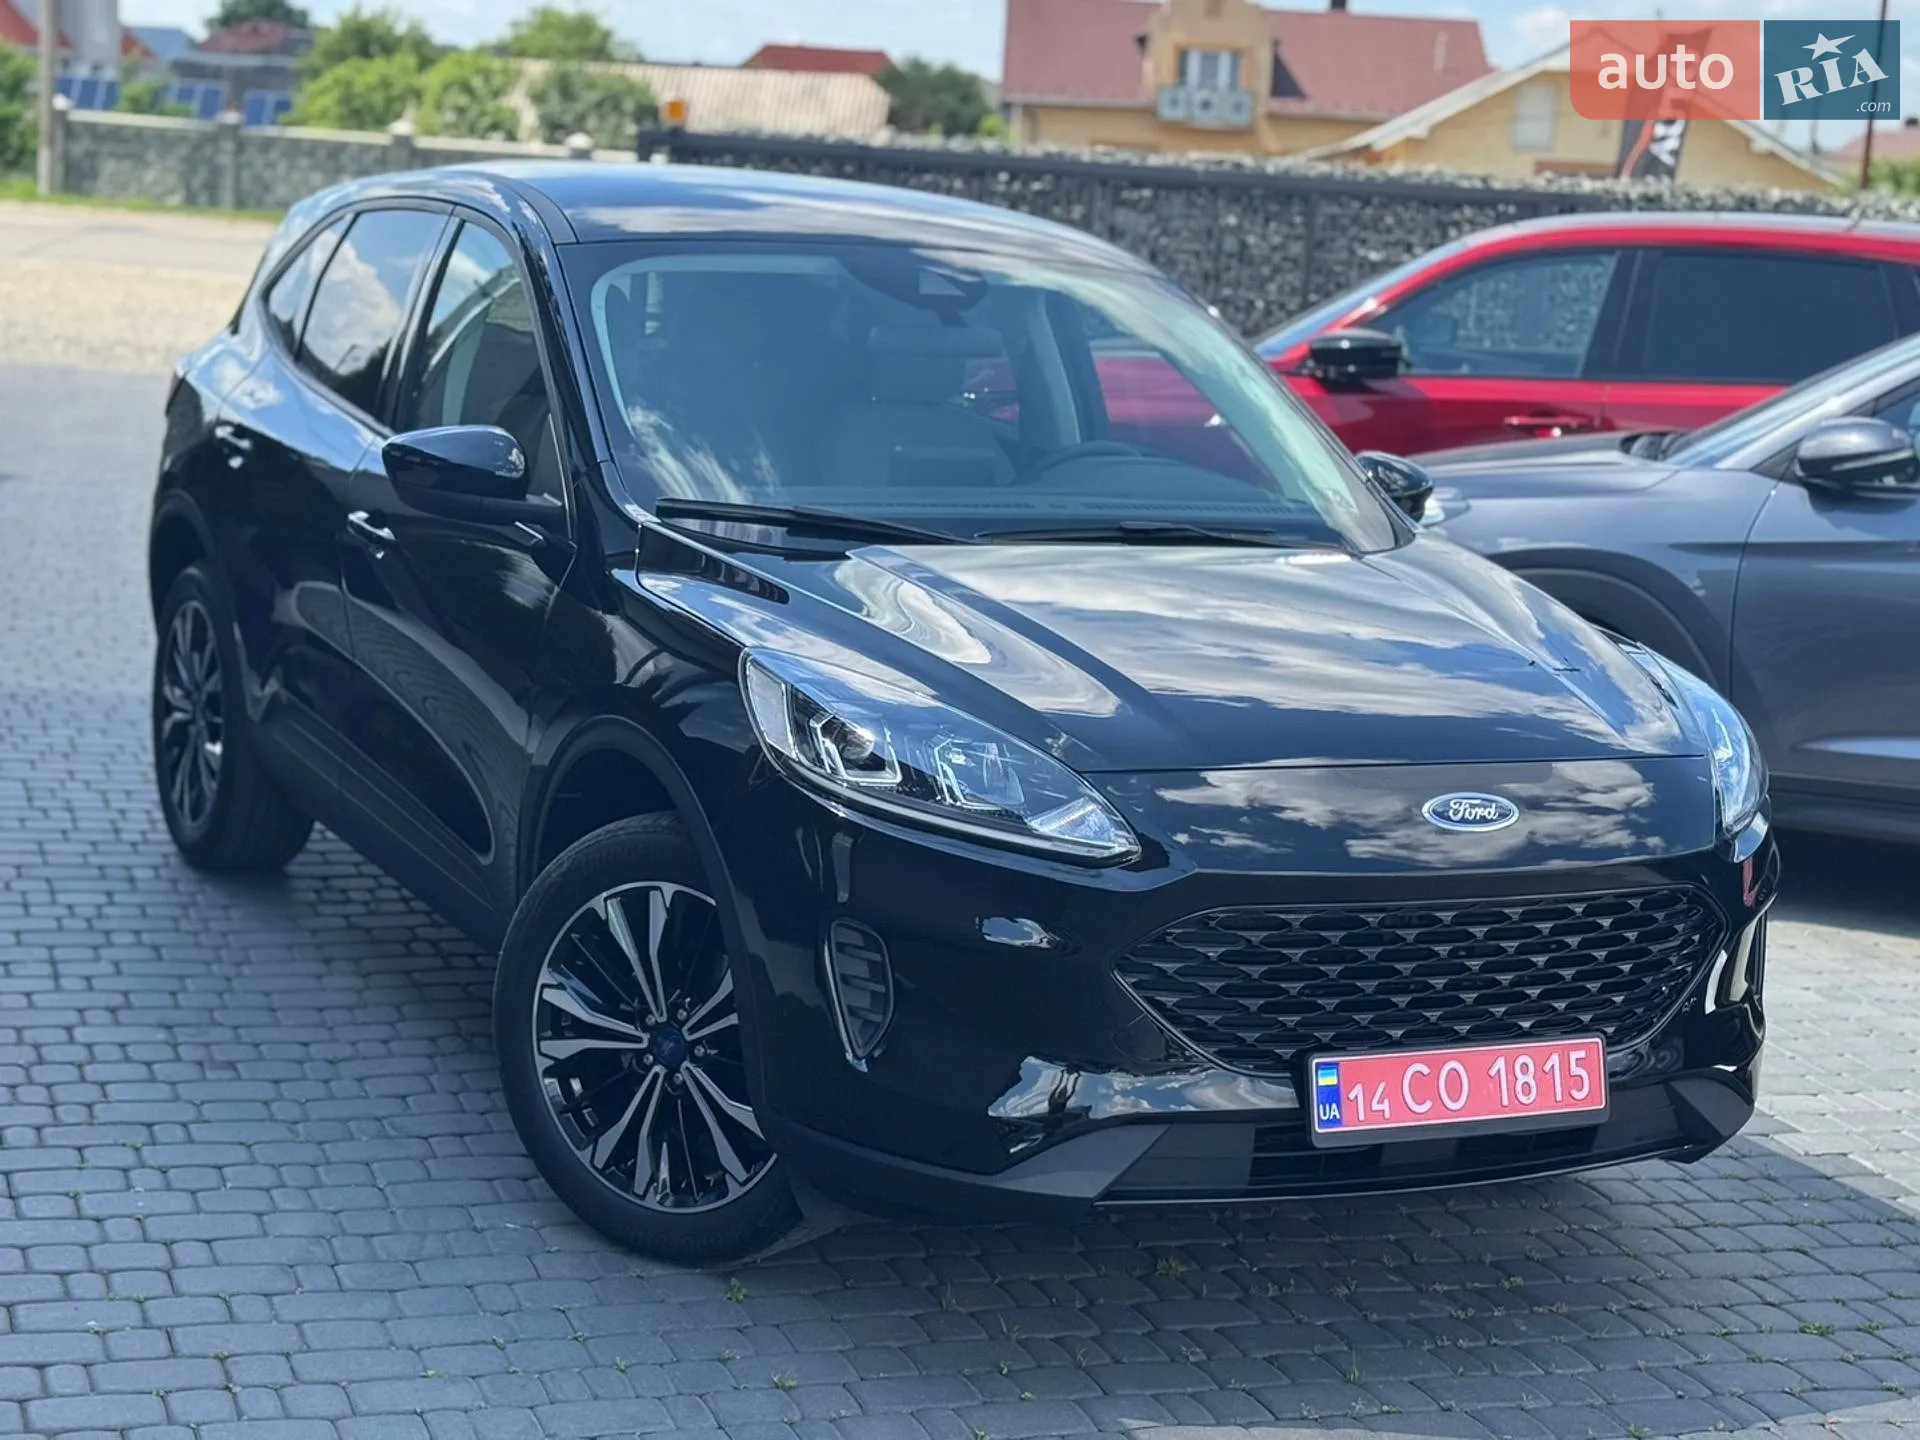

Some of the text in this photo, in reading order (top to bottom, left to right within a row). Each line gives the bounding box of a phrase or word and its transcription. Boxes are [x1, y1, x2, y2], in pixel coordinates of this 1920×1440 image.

[1449, 799, 1498, 821] Ford
[1348, 1050, 1590, 1121] 14 CO 1815
[1319, 1102, 1340, 1121] UA
